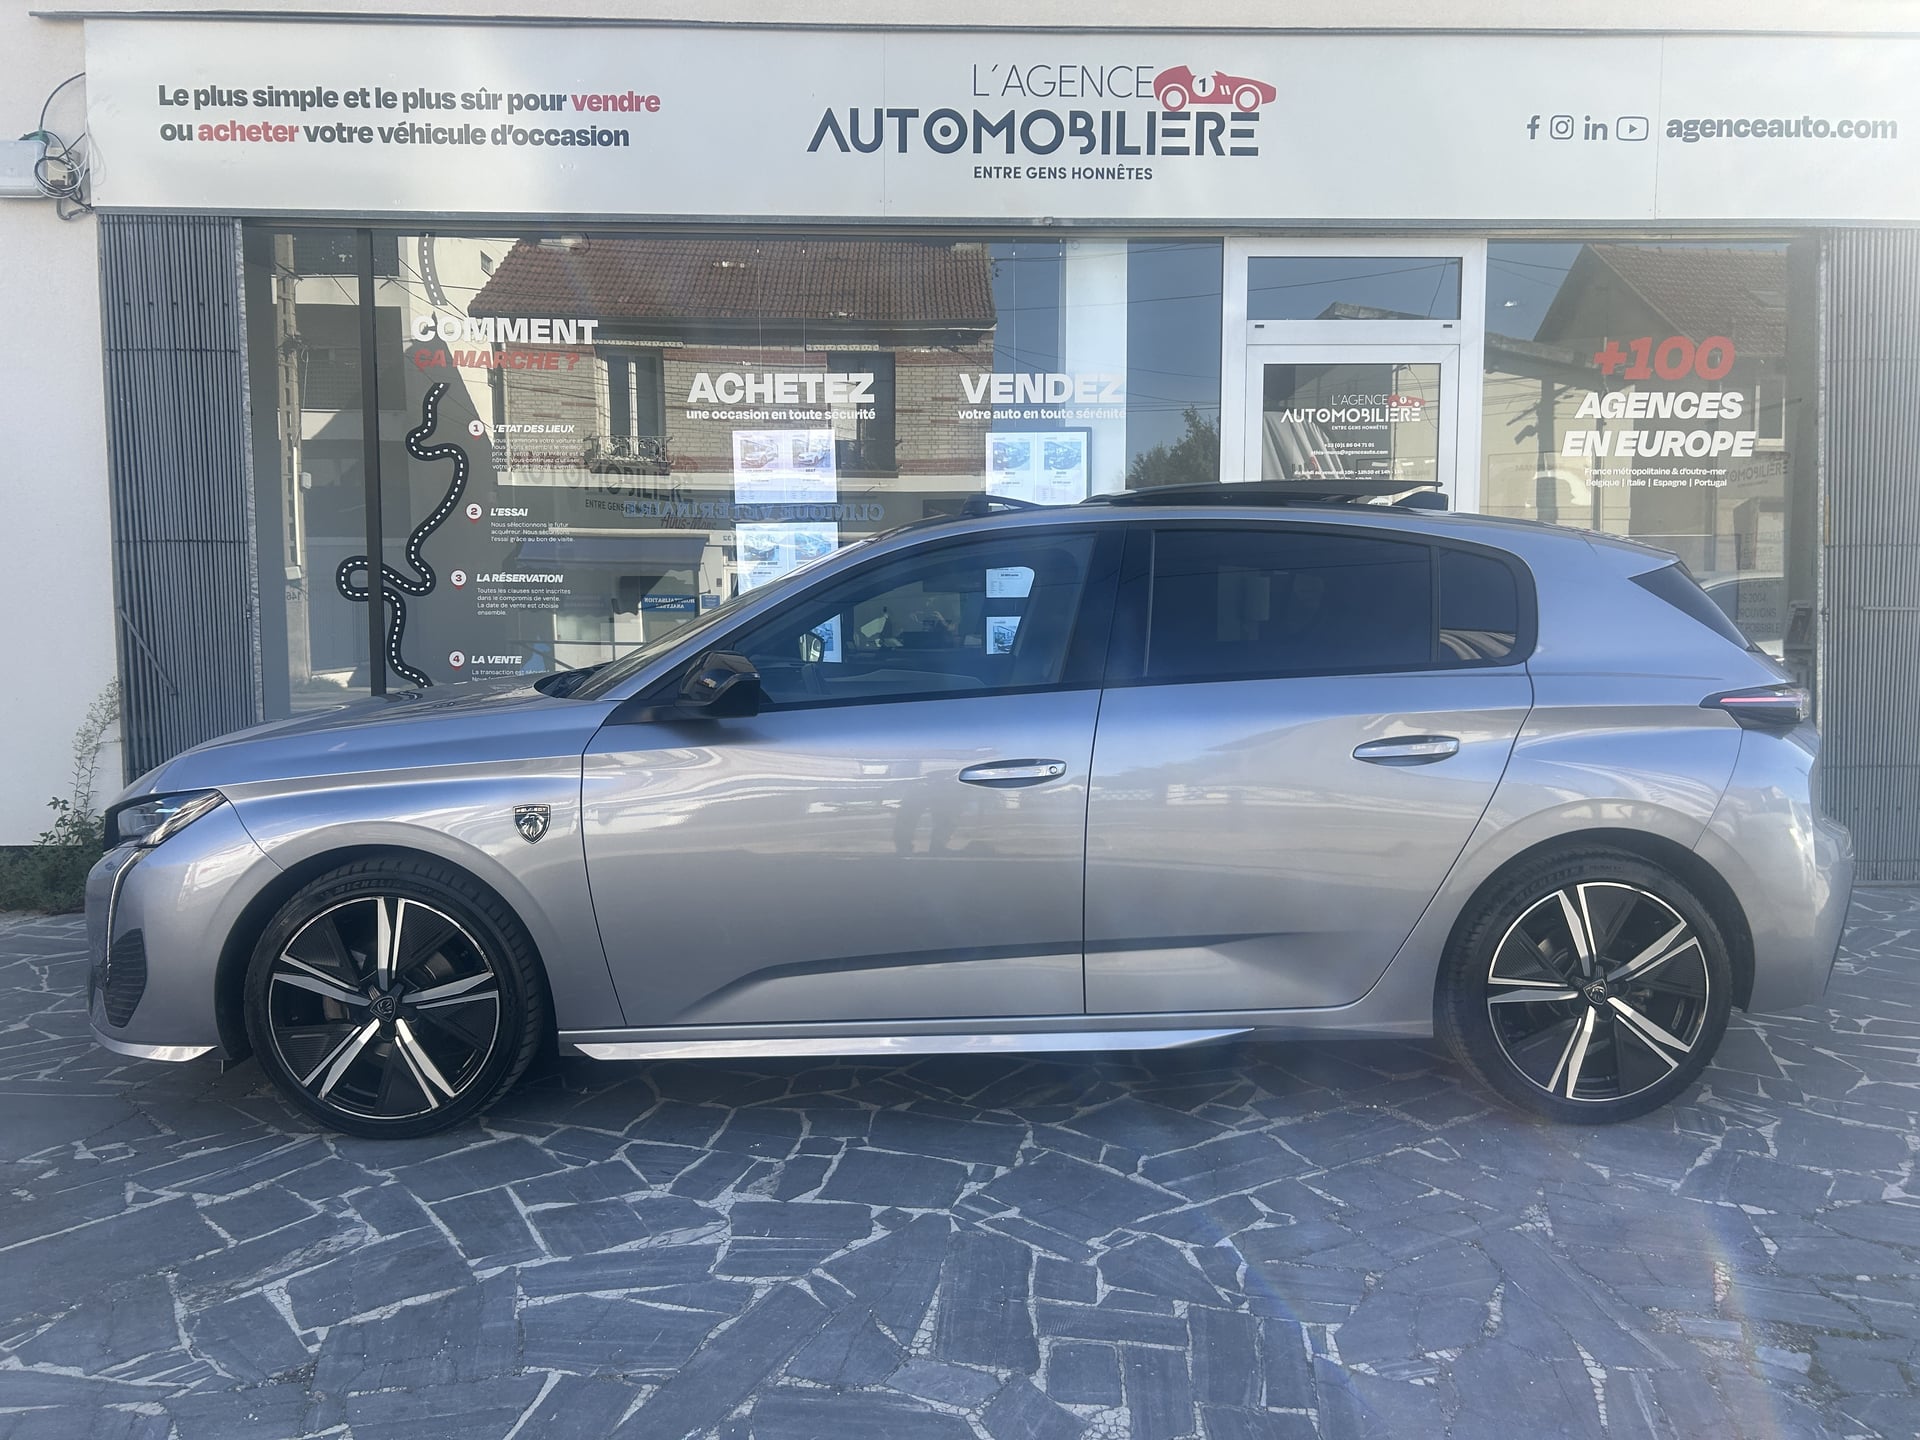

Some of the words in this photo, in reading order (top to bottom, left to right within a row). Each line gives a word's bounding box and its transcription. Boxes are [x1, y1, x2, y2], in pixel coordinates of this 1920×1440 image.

[973, 64, 1154, 98] L'AGENCE
[158, 84, 188, 106] Le
[194, 85, 248, 110] plus
[252, 86, 339, 112] simple
[343, 88, 370, 109] et
[375, 87, 398, 108] le
[402, 88, 456, 113] plus
[461, 86, 502, 110] sûr
[508, 92, 567, 114] pour
[571, 91, 660, 112] vendre
[160, 123, 193, 141] ou
[198, 120, 299, 142] acheter
[303, 122, 373, 143] votre
[378, 121, 486, 145] véhicule
[490, 124, 630, 147] d'occasion
[1666, 115, 1898, 143] agenceauto.com
[974, 166, 1022, 180] ENTRE
[1026, 166, 1068, 180] GENS
[1072, 163, 1153, 180] HONNÊTES
[411, 316, 599, 345] COMMENT
[414, 348, 447, 372] ÇA
[452, 350, 560, 371] MARCHE
[1594, 336, 1736, 380] +100
[687, 372, 875, 404] ACHETEZ
[959, 373, 1126, 404] VENDEZ
[686, 410, 709, 420] une
[712, 409, 770, 420] occasion
[772, 410, 787, 420] en
[789, 410, 822, 420] toute
[824, 408, 876, 420] sécurité
[958, 409, 992, 420] votre
[993, 409, 1022, 420] auto
[1023, 410, 1039, 420] en
[1040, 409, 1075, 420] toute
[1076, 408, 1126, 420] sérénité
[1575, 391, 1744, 420] AGENCES
[492, 424, 522, 433] L'ETAT
[524, 424, 545, 433] DES
[546, 424, 575, 433] LIEUX
[1561, 430, 1612, 458] EN
[1614, 430, 1756, 458] EUROPE
[1584, 468, 1612, 476] France
[1613, 467, 1670, 477] métropolitaine
[1680, 467, 1727, 476] d'outre-mer
[1586, 479, 1620, 488] Belgique
[1653, 479, 1686, 488] Espagne
[1694, 479, 1727, 488] Portugal
[490, 508, 528, 516] L'ESSAI
[585, 499, 606, 510] ENTRE
[608, 502, 624, 512] GENS
[476, 574, 490, 582] LA
[492, 572, 564, 583] RÉSERVATION
[471, 656, 486, 664] LA
[488, 656, 522, 664] VENTE
